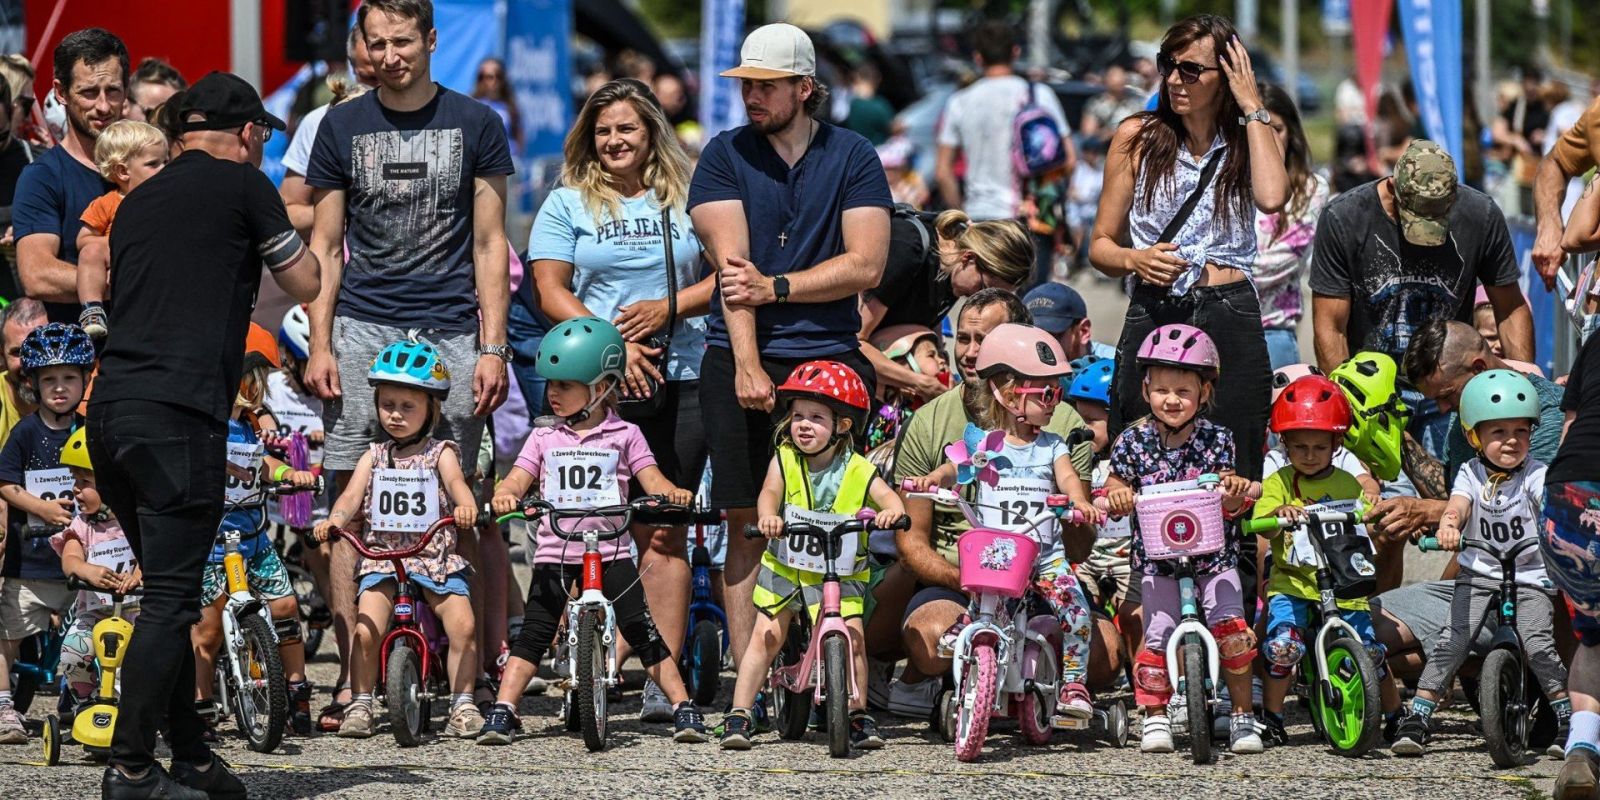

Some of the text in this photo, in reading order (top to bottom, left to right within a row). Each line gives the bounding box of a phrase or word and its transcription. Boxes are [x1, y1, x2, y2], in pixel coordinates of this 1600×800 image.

[1370, 274, 1459, 300] METALLICA
[577, 450, 610, 458] Rowerkowe
[558, 465, 602, 490] 102
[1020, 485, 1050, 493] Rowerkowe
[379, 490, 427, 517] 063
[1000, 500, 1045, 525] 127
[795, 512, 814, 524] Zawody
[1480, 516, 1525, 543] 008
